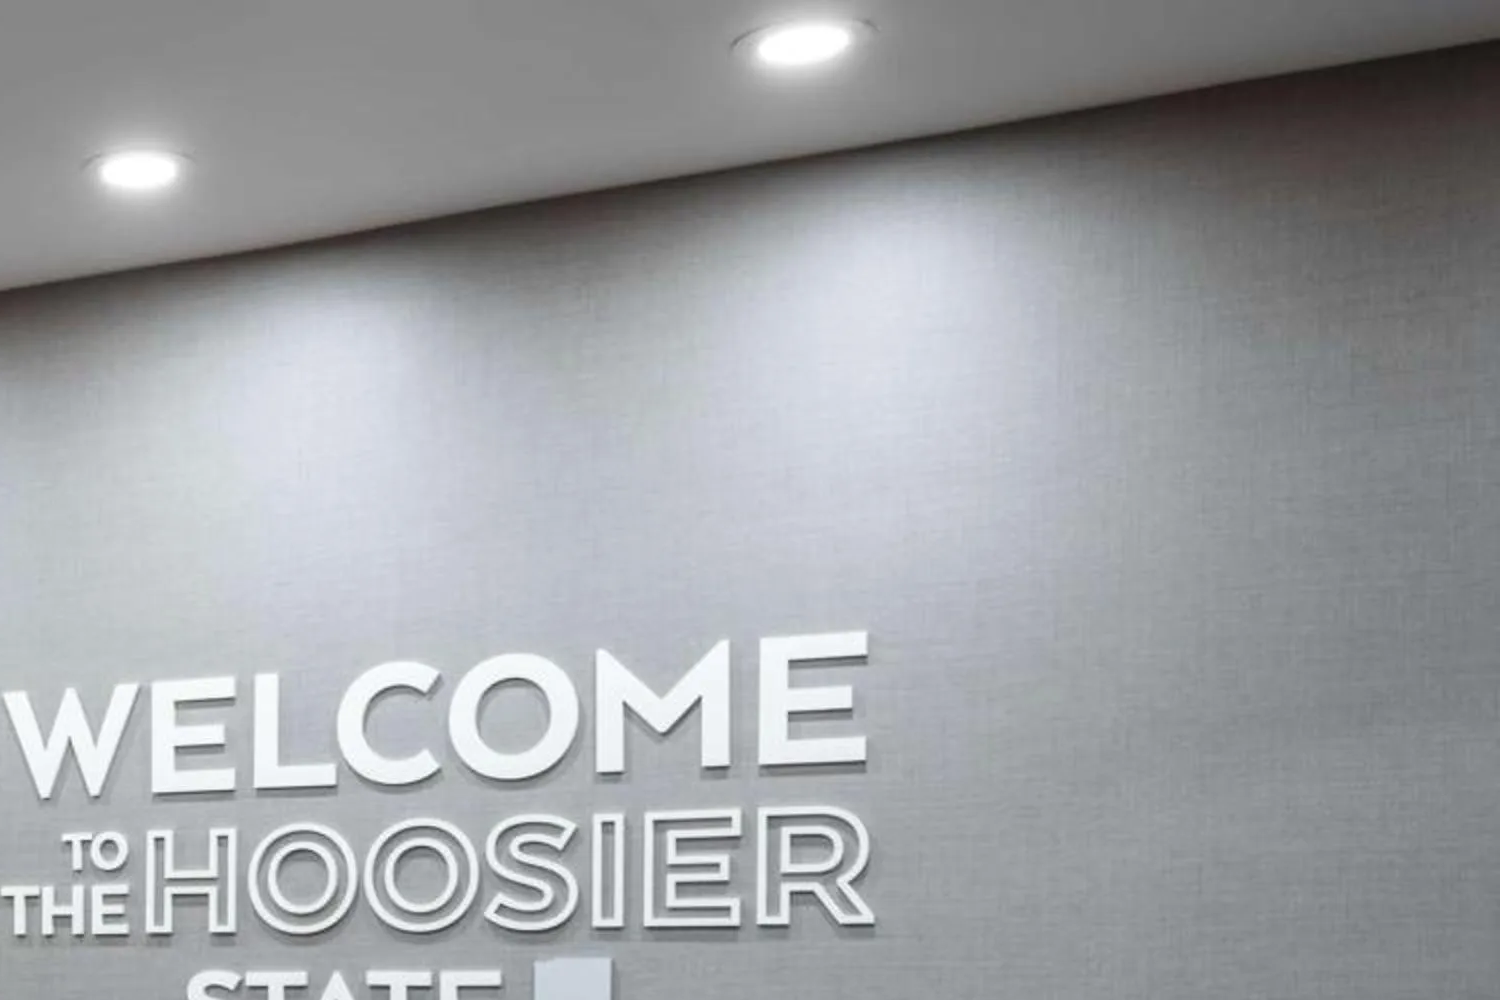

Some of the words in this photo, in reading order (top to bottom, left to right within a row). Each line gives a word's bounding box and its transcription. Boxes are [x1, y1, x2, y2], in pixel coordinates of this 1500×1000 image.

[1, 630, 869, 799] WELCOME
[0, 883, 130, 936] THE
[145, 805, 875, 936] HOOSIER
[62, 831, 128, 872] TO
